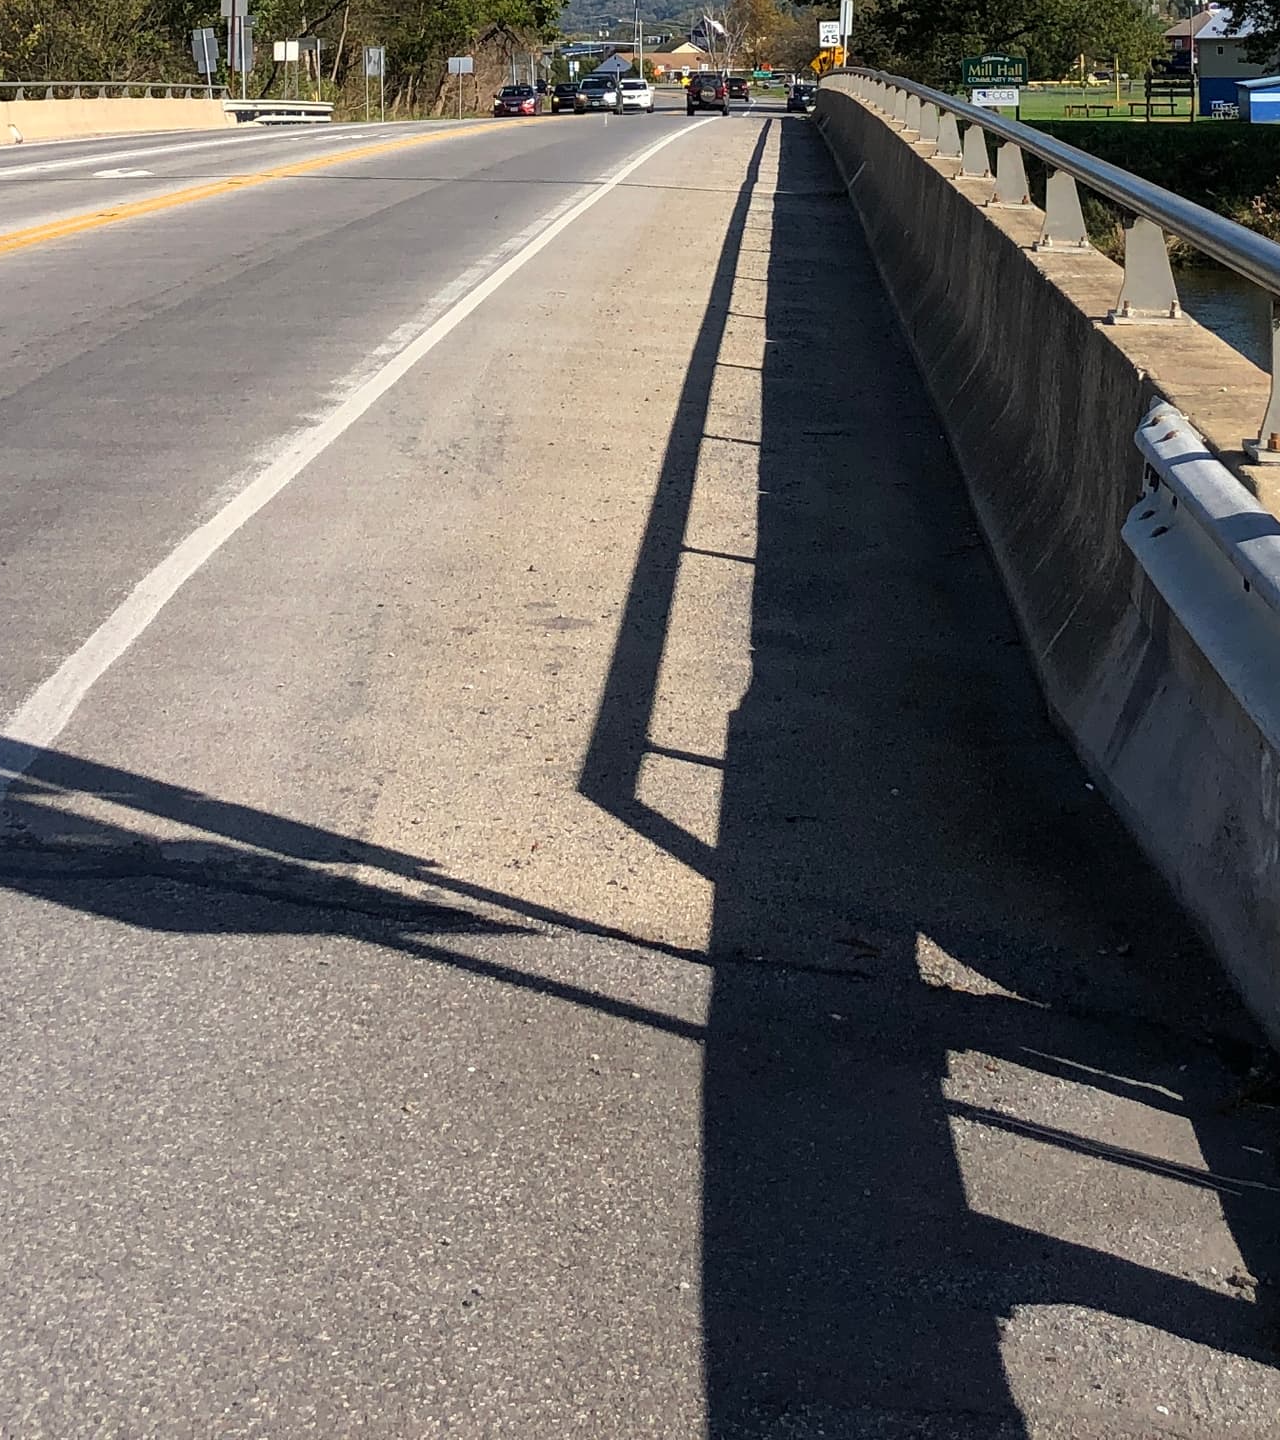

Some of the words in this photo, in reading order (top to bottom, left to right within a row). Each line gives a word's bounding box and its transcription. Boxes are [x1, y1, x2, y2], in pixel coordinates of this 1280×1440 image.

[822, 34, 839, 44] 45
[968, 63, 992, 76] Mill
[997, 63, 1023, 76] Hall
